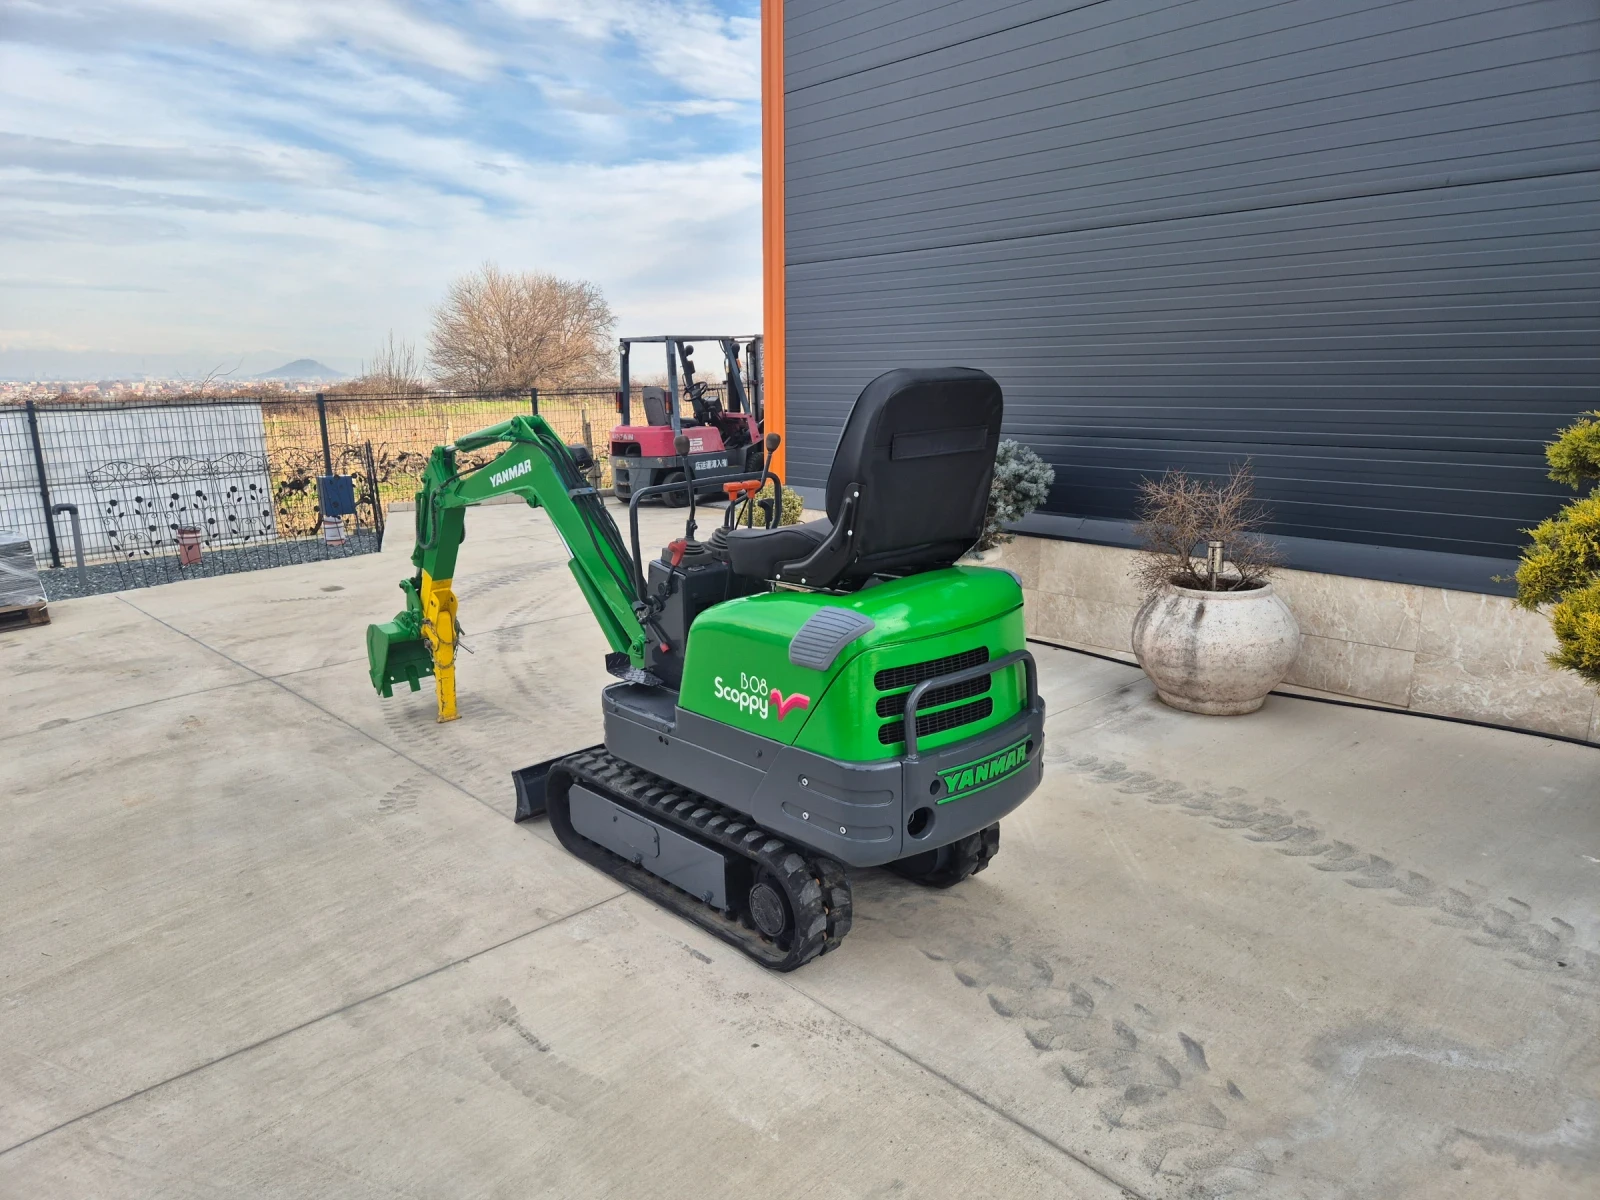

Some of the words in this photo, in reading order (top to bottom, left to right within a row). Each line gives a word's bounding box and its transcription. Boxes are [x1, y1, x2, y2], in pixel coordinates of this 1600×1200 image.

[489, 459, 532, 488] YANMAR
[714, 676, 769, 719] Scoppy
[944, 743, 1027, 794] YANMAR
